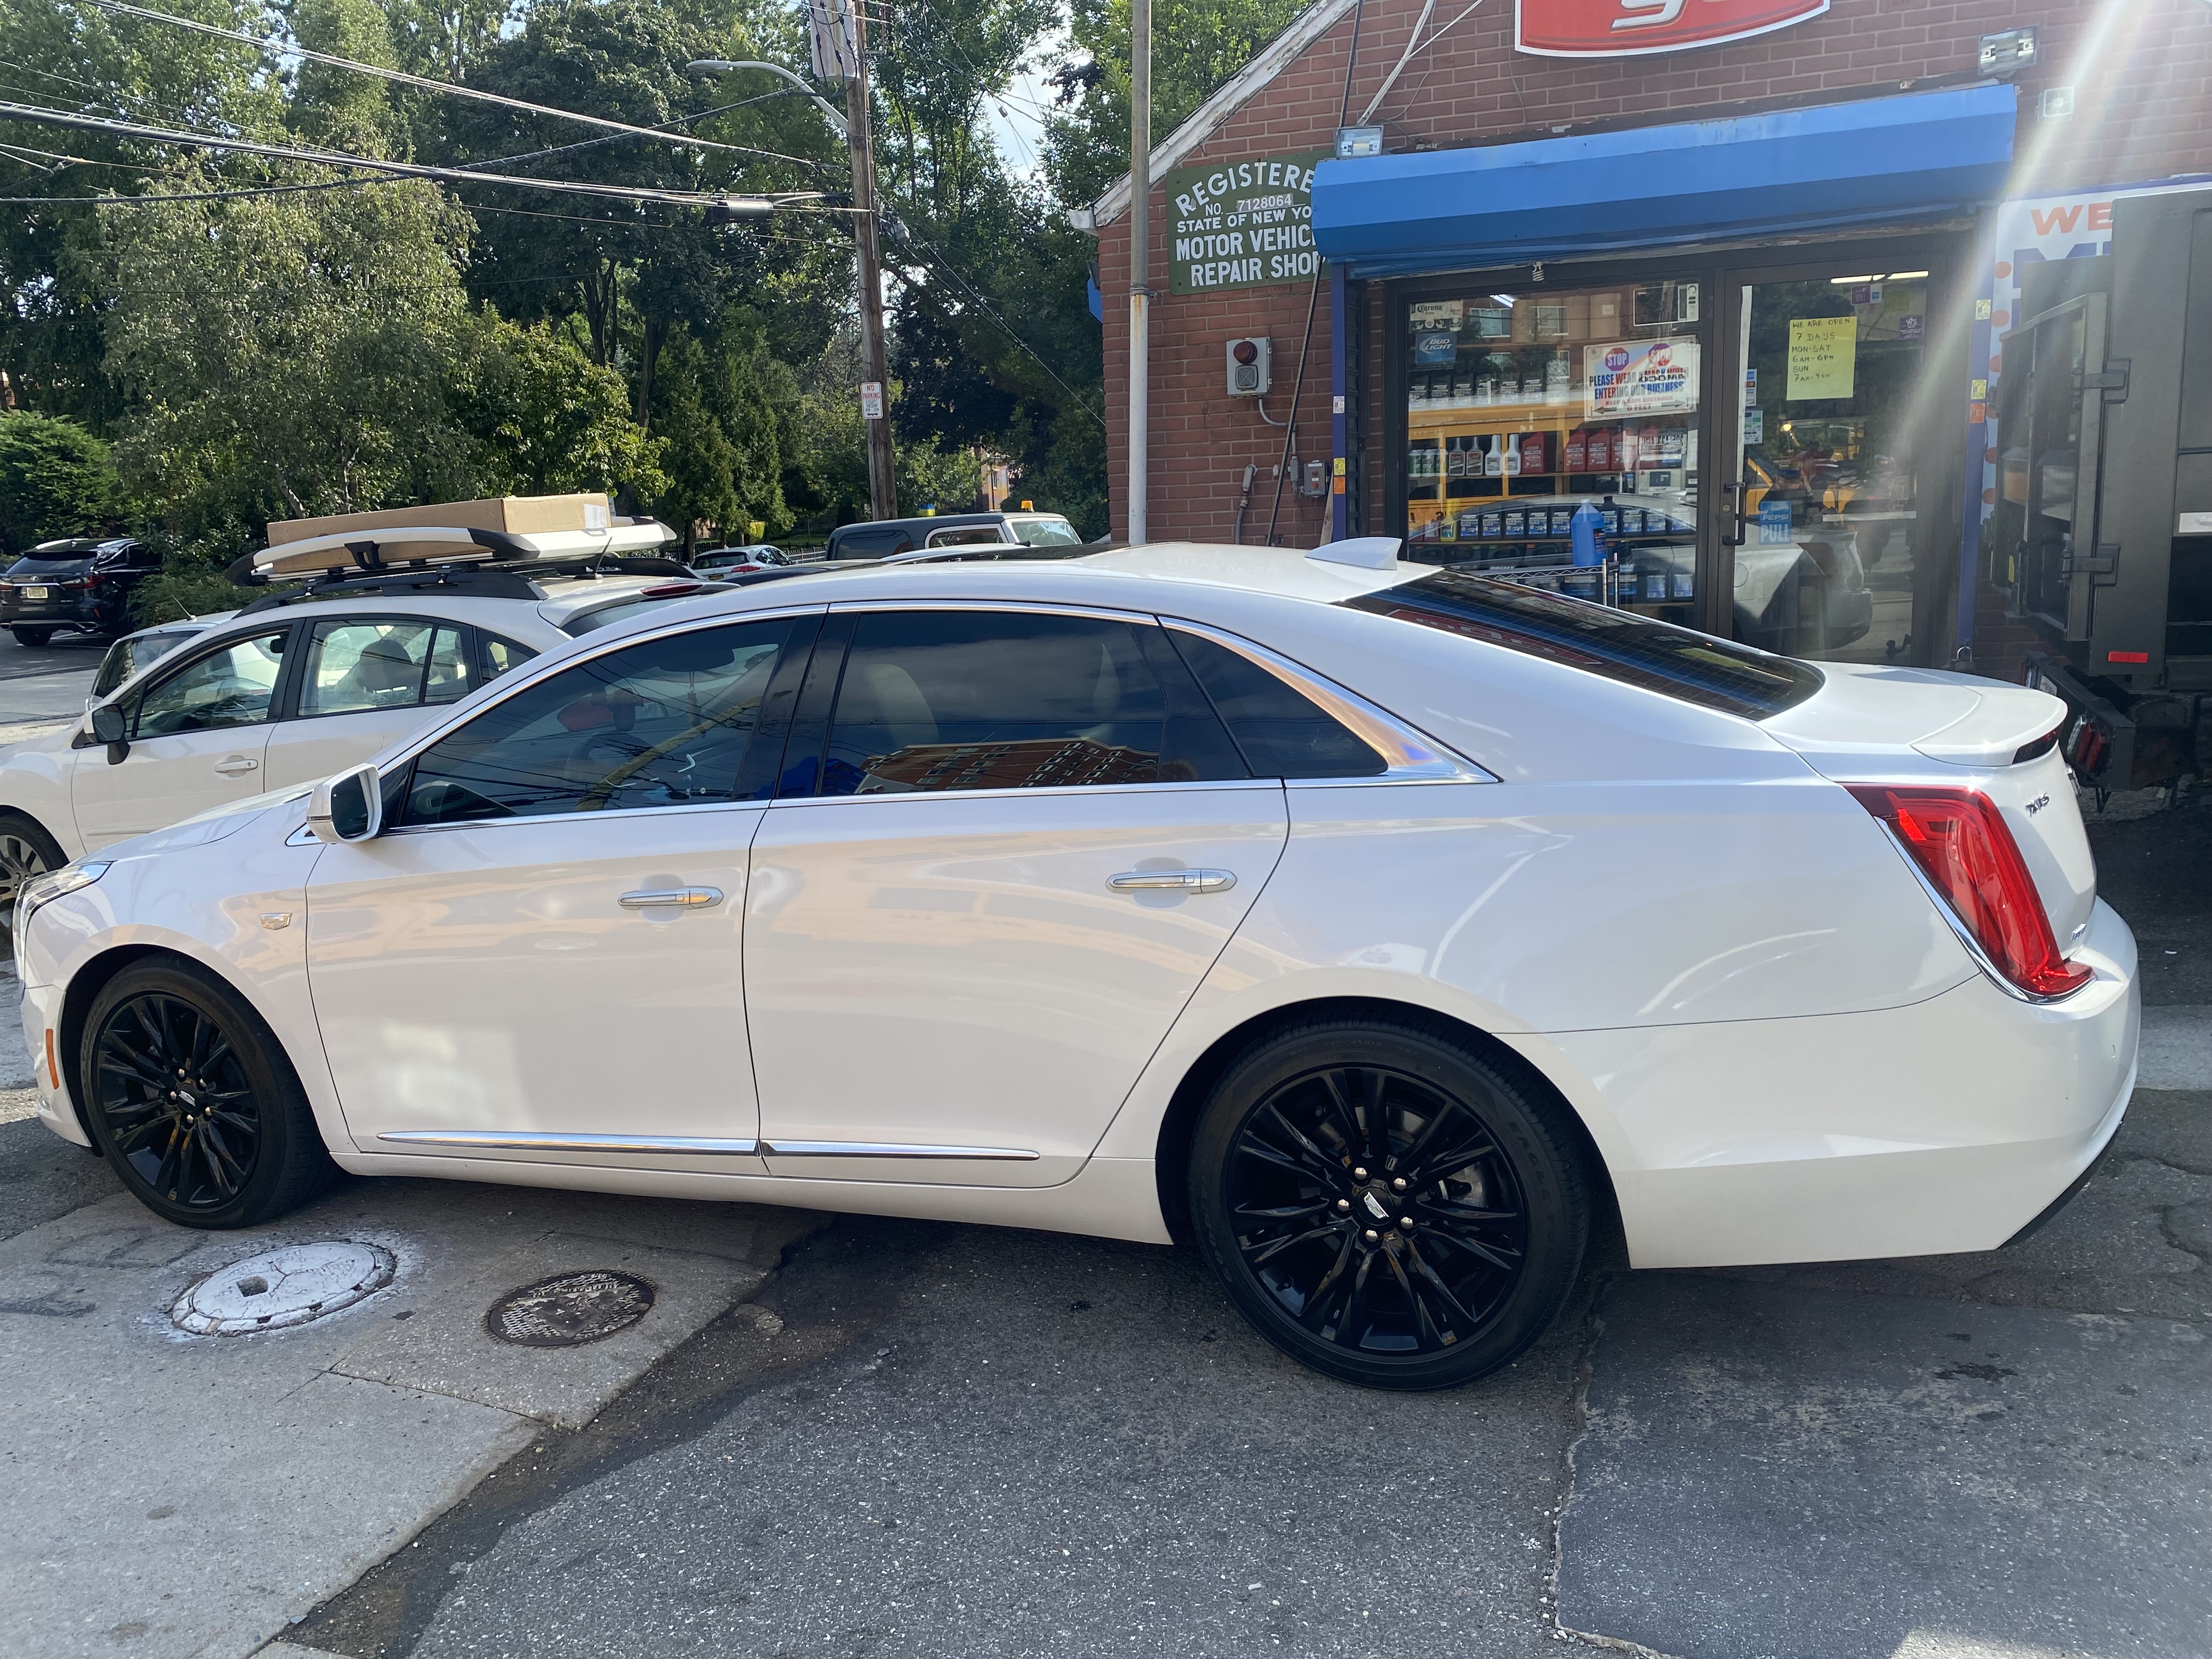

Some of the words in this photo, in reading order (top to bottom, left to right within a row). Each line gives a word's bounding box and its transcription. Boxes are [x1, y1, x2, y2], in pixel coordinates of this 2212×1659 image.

[1205, 202, 1223, 216] NO.
[1237, 193, 1292, 212] 7128064
[1177, 217, 1221, 233] STATE
[1227, 213, 1247, 227] OF
[1253, 209, 1285, 224] NEW
[1176, 232, 1243, 261] MOTOR
[1249, 224, 1317, 253] VEHIC
[1190, 257, 1262, 287] REPAIR
[1418, 304, 1442, 313] Corona
[1807, 332, 1835, 341] DAYS
[1607, 354, 1627, 366] STOP
[1651, 349, 1671, 362] STOP
[1589, 374, 1614, 386] PLEASE
[1616, 372, 1637, 384] WEAR
[1595, 386, 1629, 399] ENTERING
[1631, 384, 1645, 396] OUR
[1647, 381, 1684, 394] BUSINESS
[1760, 523, 1790, 543] PULL
